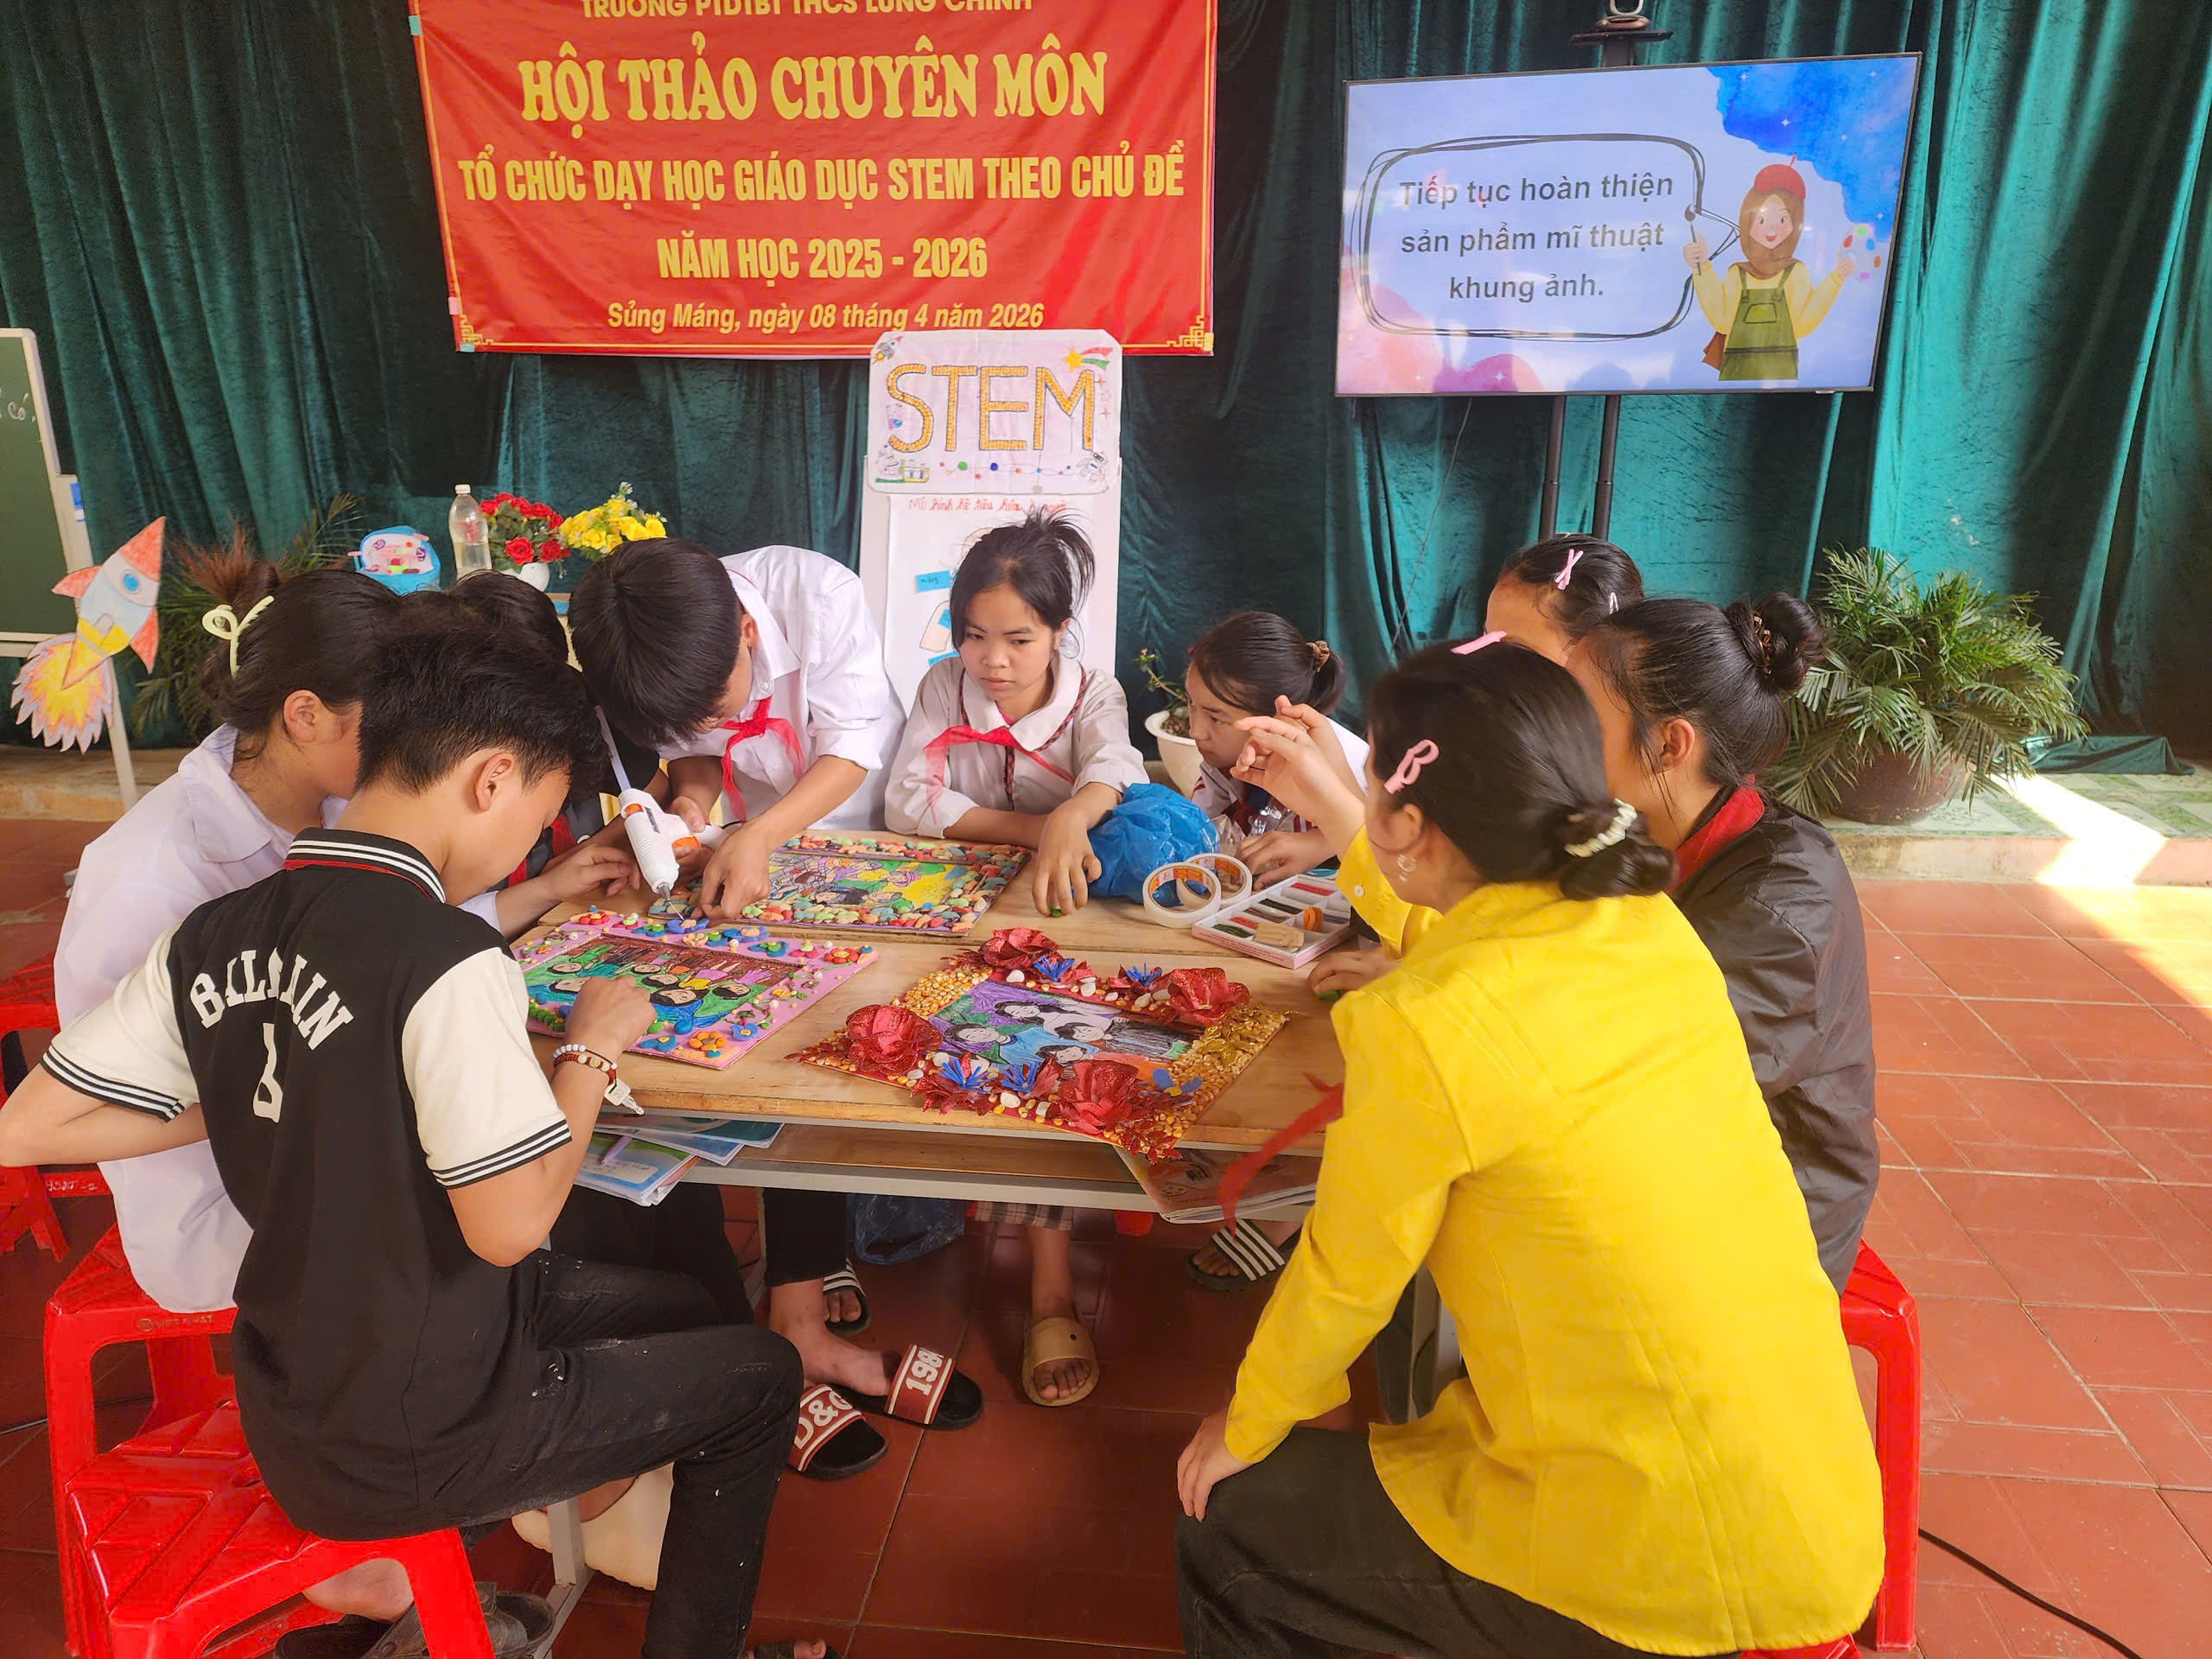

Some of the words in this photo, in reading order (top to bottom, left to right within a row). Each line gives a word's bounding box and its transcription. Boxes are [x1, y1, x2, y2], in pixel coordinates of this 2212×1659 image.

[518, 41, 610, 139] HỘI
[618, 31, 757, 121] THẢO
[771, 35, 979, 120] CHUYÊN
[993, 33, 1108, 118] MÔN
[457, 143, 497, 201] TỔ
[505, 150, 587, 201] CHỨC
[594, 159, 653, 210] DẠY
[663, 159, 725, 211] HỌC
[734, 150, 807, 201] GIÁO
[815, 158, 879, 210] DỤC
[887, 158, 975, 200] STEM
[982, 156, 1061, 199] THEO
[1071, 140, 1135, 198] CHỦ
[1142, 139, 1185, 196] ĐỀ
[1399, 175, 1458, 209] Tiếp
[1467, 181, 1510, 208] tục
[1520, 175, 1590, 201] hoàn
[1601, 172, 1673, 202] thiện
[656, 230, 730, 278] NĂM
[736, 238, 800, 287] HỌC
[808, 238, 883, 278] 2025
[891, 255, 905, 265] -
[912, 237, 988, 278] 2026
[1401, 229, 1449, 253] sản
[1459, 221, 1535, 257] phẩm
[1547, 225, 1583, 248] mĩ
[1590, 223, 1664, 251] thuật
[1449, 276, 1535, 303] khung
[1545, 273, 1604, 296] ảnh.
[607, 300, 666, 334] Sủng
[672, 302, 741, 334] Máng,
[748, 302, 804, 334] ngày
[810, 303, 837, 328] 08
[842, 302, 909, 333] tháng
[914, 302, 929, 327] 4
[934, 302, 983, 327] năm
[988, 302, 1046, 328] 2026
[887, 363, 1095, 453] STEM
